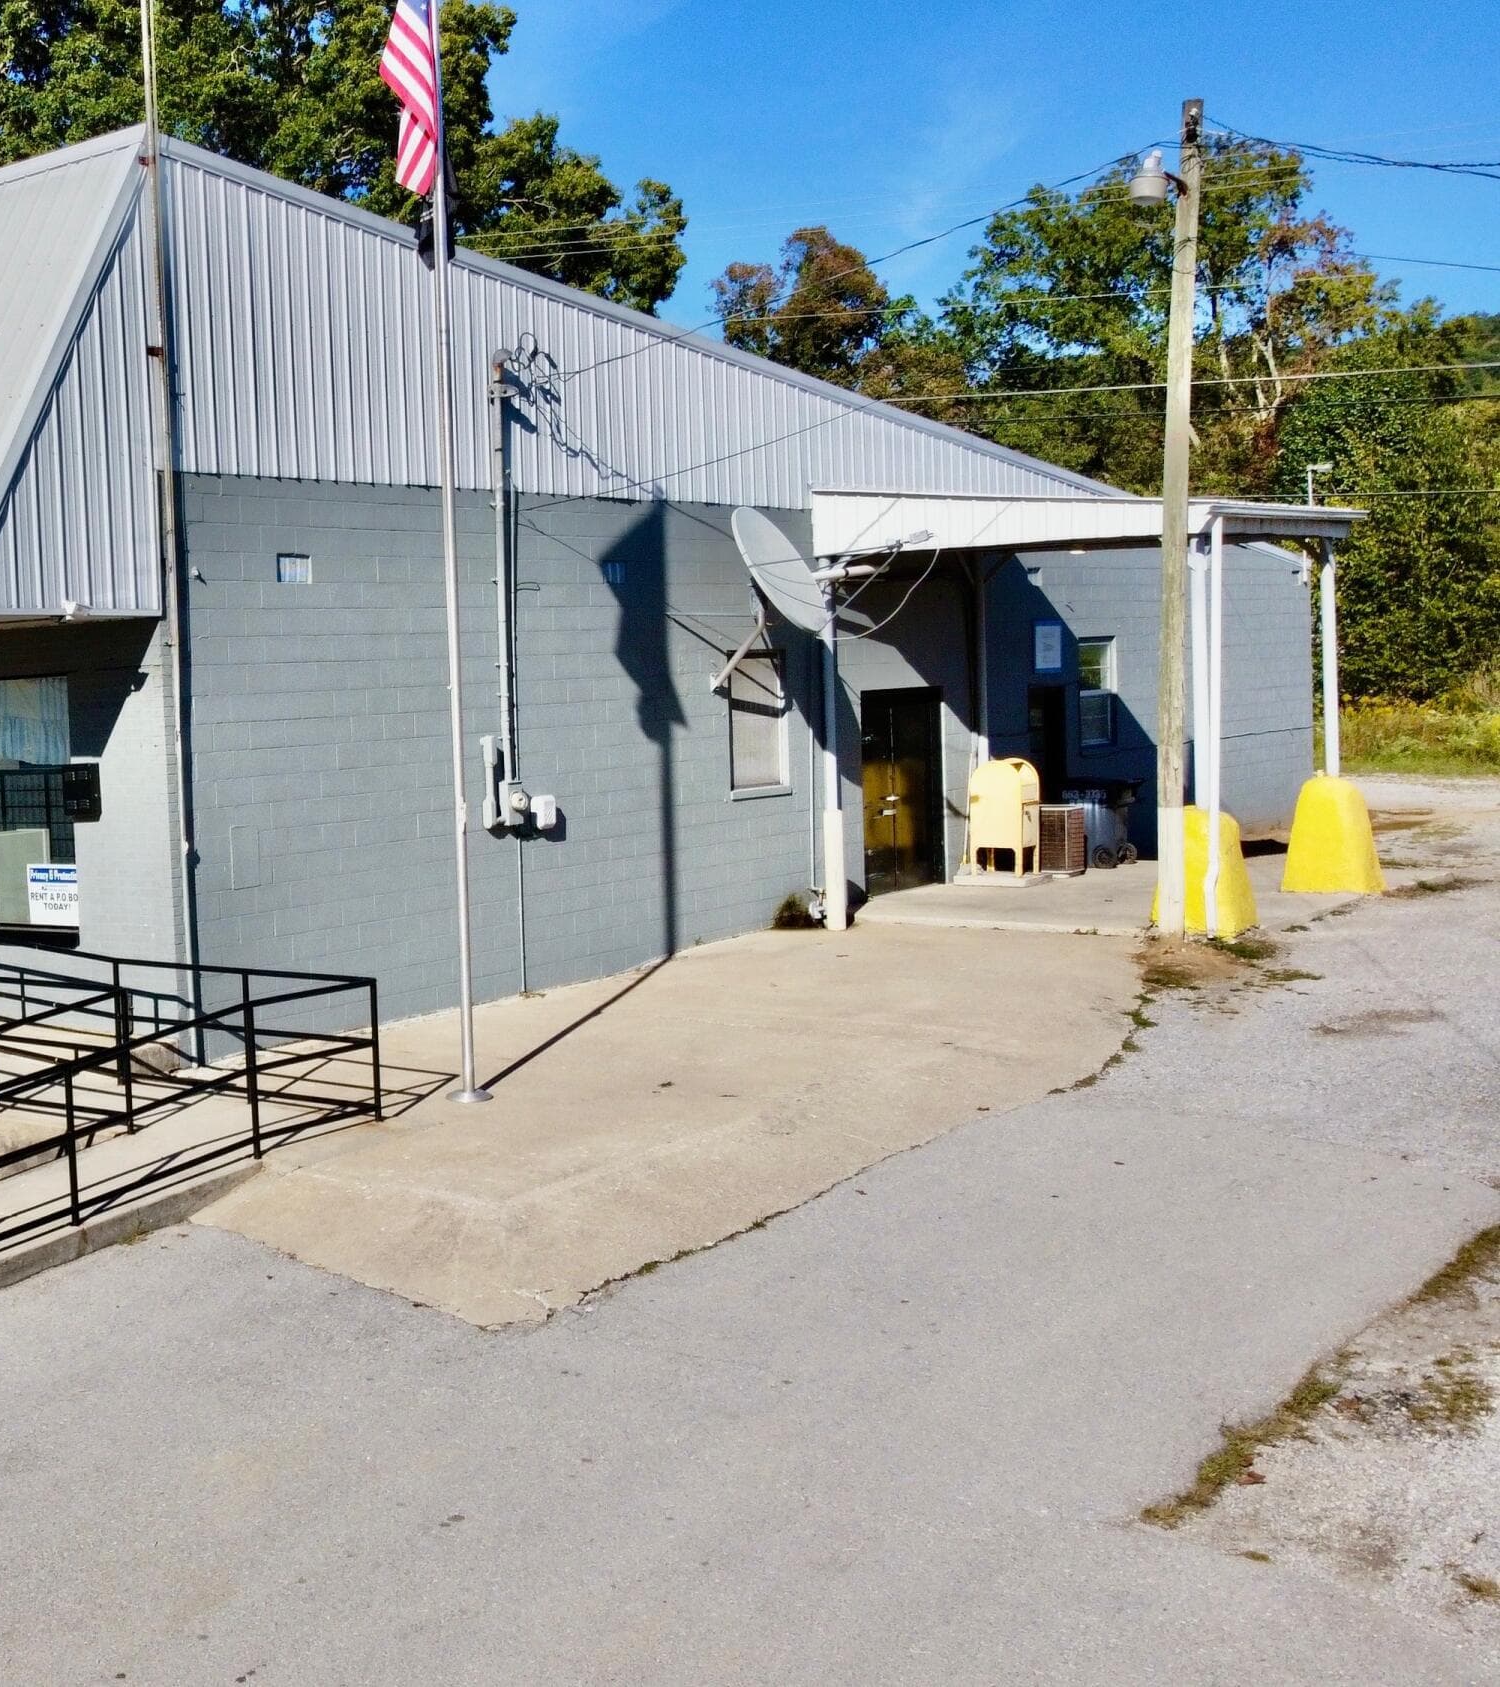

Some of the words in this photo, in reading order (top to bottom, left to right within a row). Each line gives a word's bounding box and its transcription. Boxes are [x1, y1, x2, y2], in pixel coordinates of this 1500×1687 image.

[30, 892, 48, 901] RENT
[50, 892, 55, 901] A
[68, 893, 79, 902] BO
[44, 902, 71, 911] TODAY!
